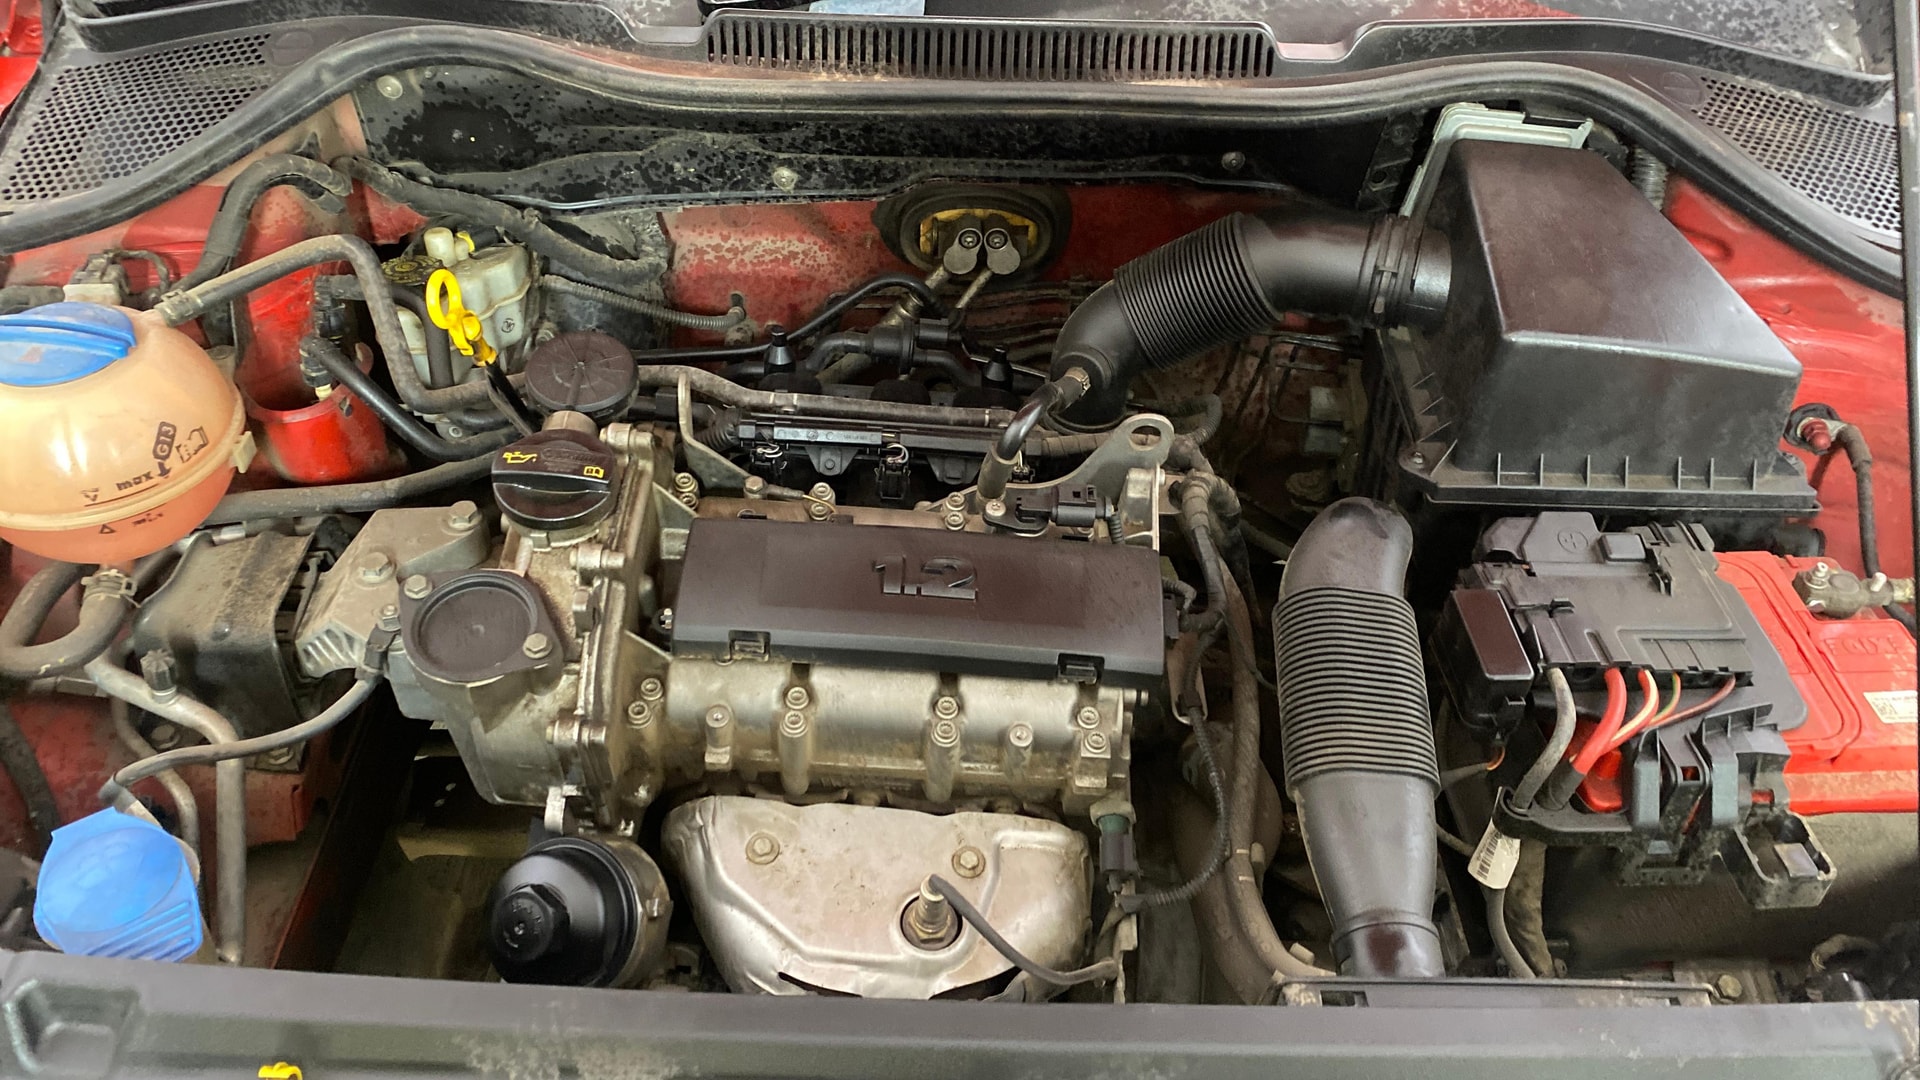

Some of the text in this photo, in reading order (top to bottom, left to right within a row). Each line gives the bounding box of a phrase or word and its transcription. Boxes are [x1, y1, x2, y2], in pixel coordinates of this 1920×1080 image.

[155, 424, 174, 458] G13
[115, 471, 154, 491] max
[873, 555, 978, 600] 1.2
